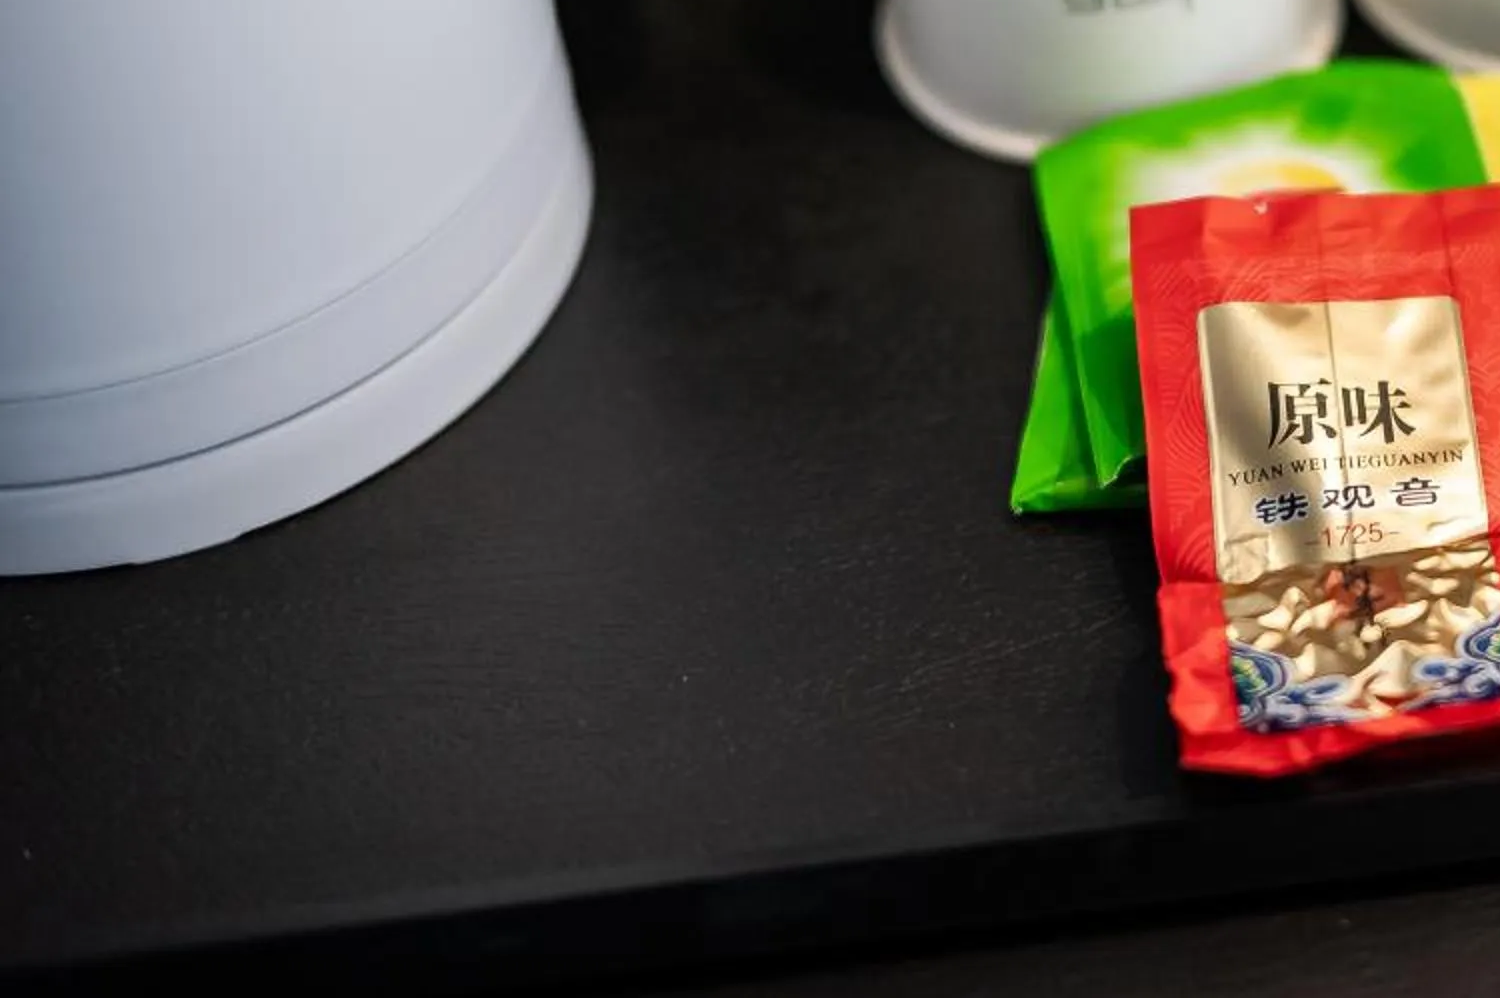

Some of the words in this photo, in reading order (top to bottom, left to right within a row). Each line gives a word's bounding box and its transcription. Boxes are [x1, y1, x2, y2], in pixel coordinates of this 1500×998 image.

[1268, 378, 1417, 449] 原味
[1228, 462, 1284, 486] YUAN
[1291, 457, 1328, 474] WEI
[1337, 448, 1464, 470] TIEGUANYIN
[1255, 477, 1440, 524] 铁观音
